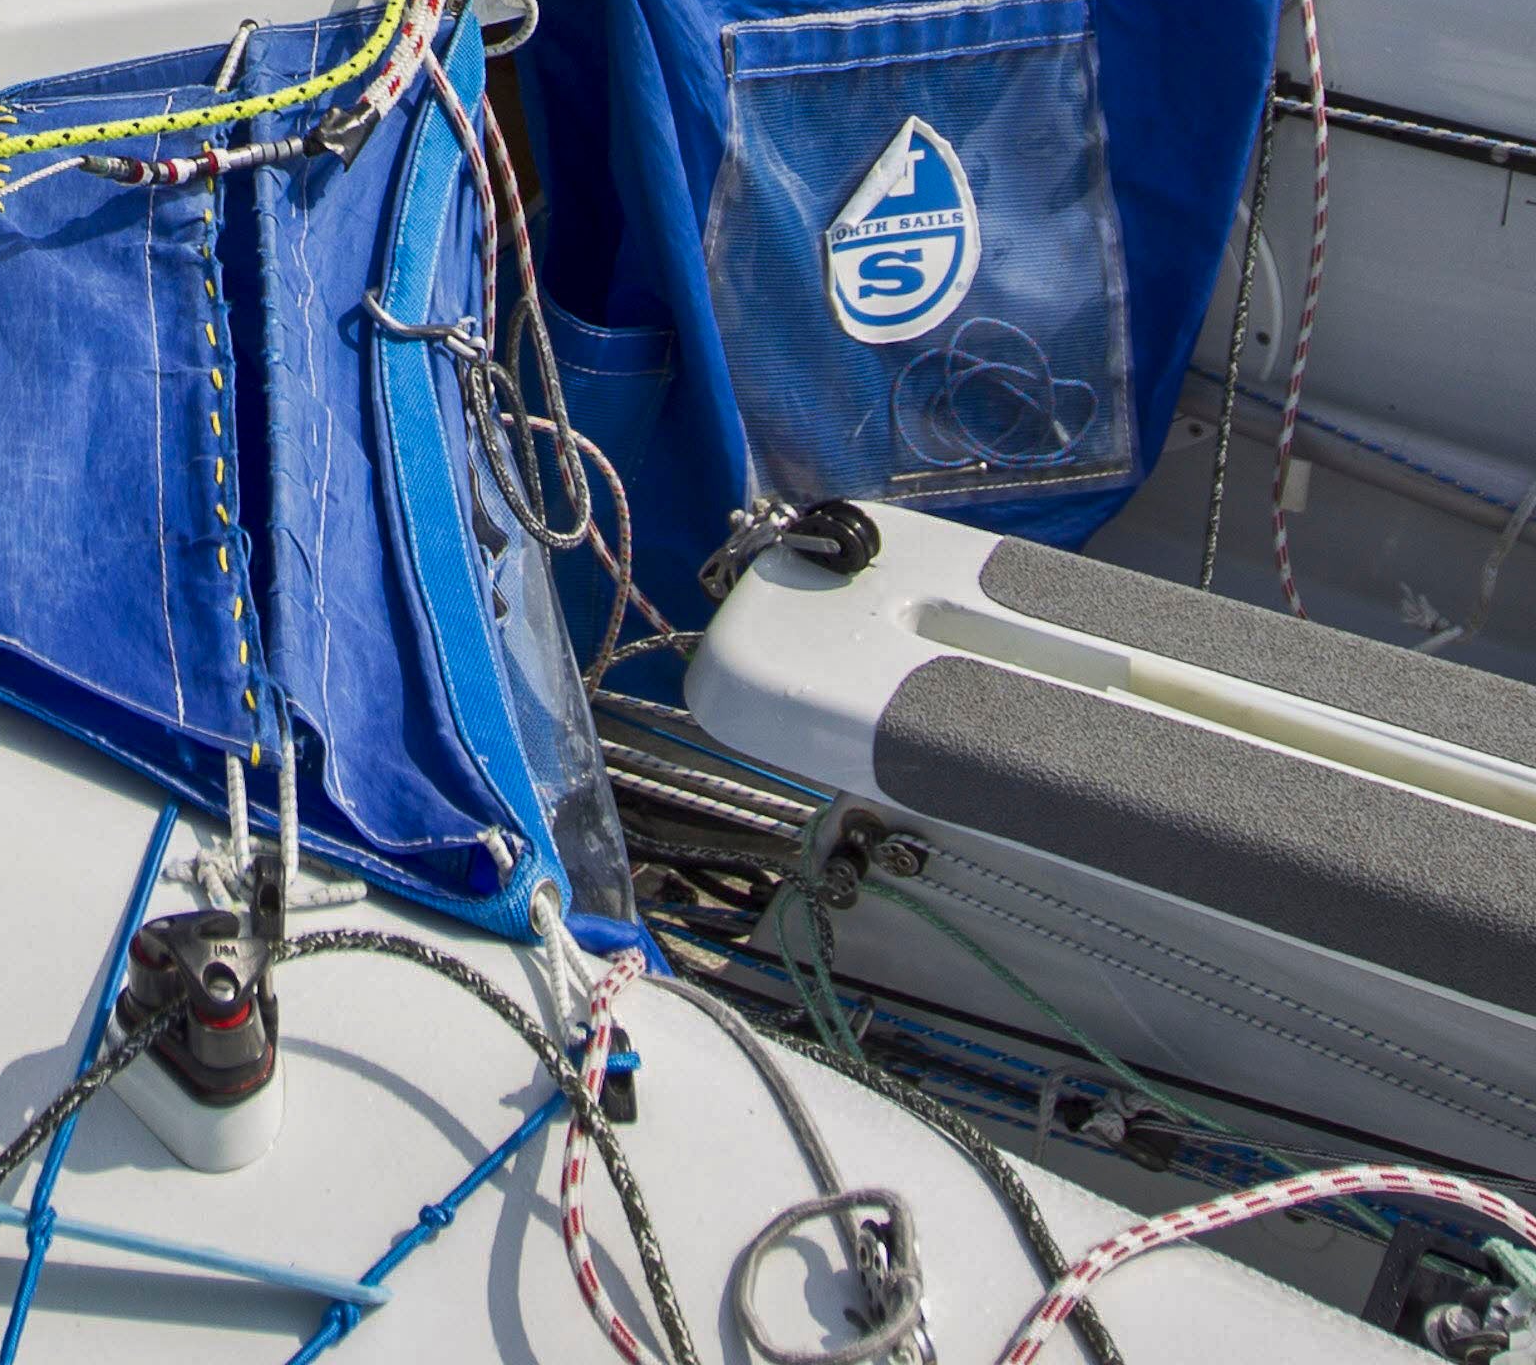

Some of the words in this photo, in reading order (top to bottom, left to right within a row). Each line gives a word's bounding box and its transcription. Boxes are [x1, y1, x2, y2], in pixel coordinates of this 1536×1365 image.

[831, 220, 888, 242] ORTH
[898, 211, 964, 230] SAILS
[858, 247, 926, 300] S
[214, 943, 239, 959] USA
